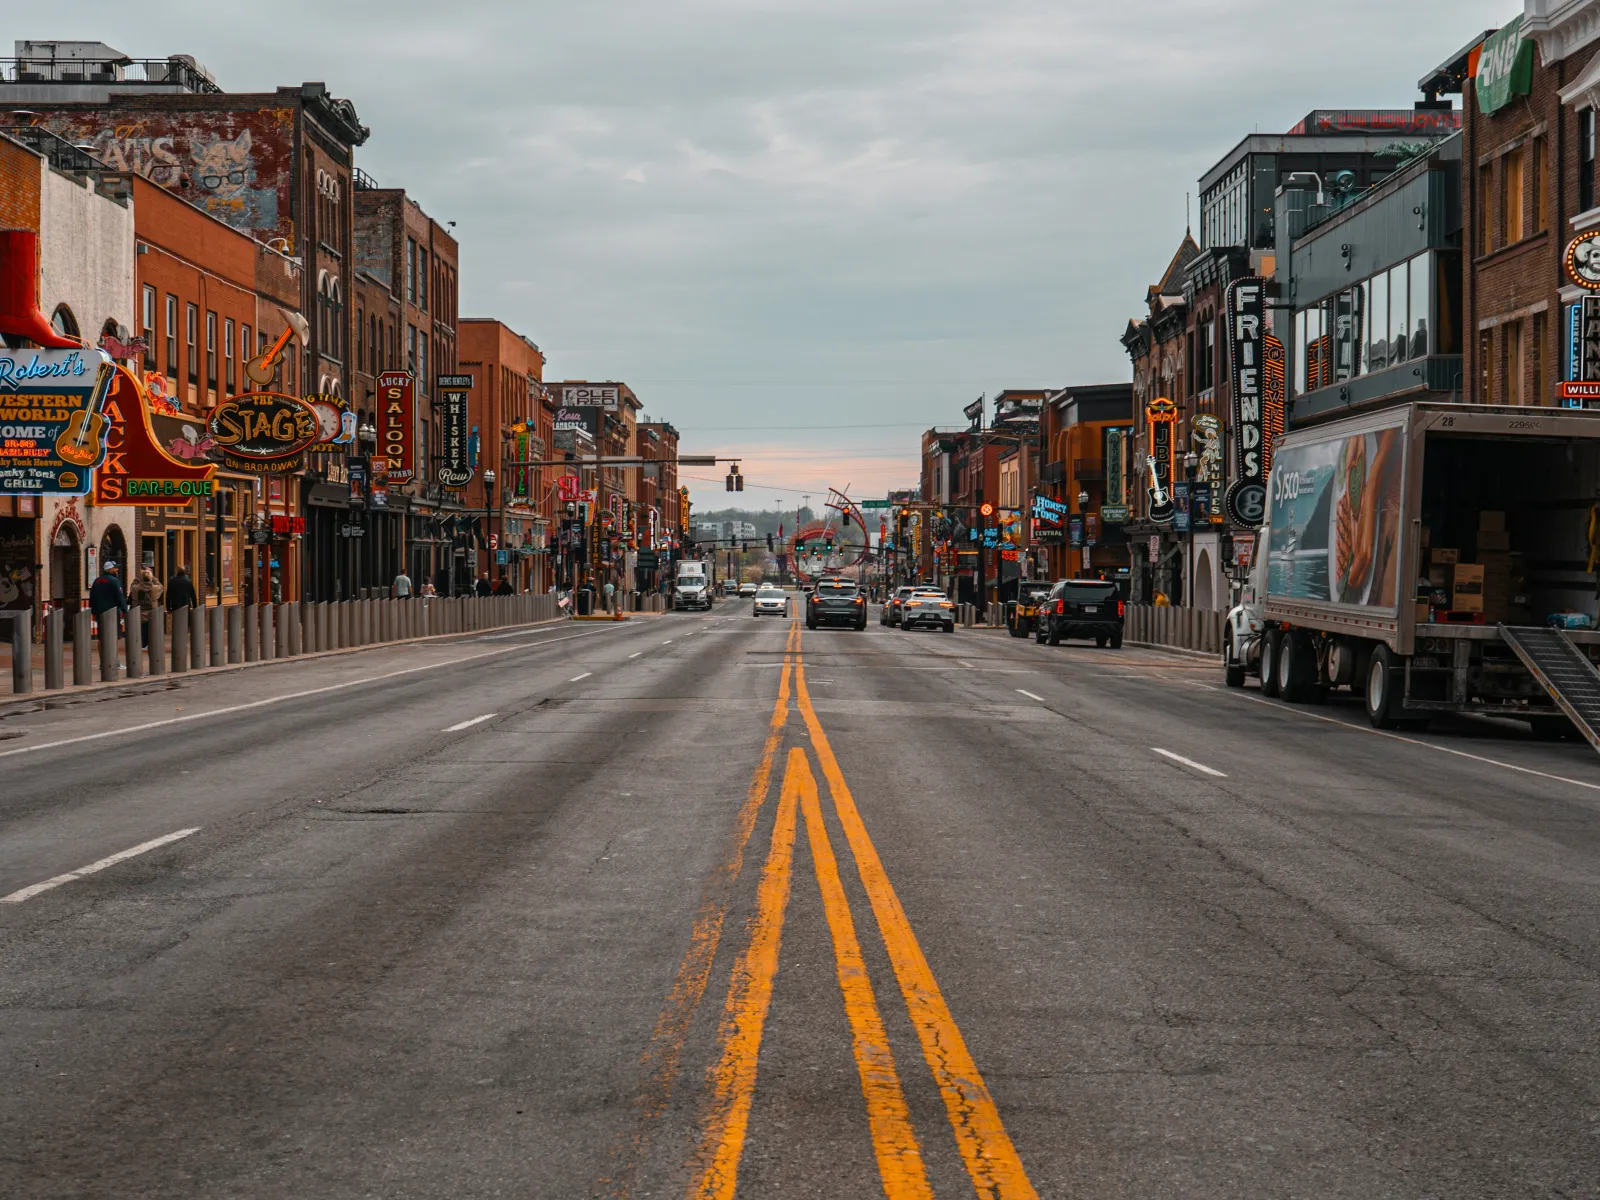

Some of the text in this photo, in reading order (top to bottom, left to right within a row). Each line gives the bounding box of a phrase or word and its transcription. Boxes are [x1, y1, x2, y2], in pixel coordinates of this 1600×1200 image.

[97, 130, 180, 187] ATS
[0, 352, 85, 389] Robert's
[380, 376, 410, 387] LUCKY
[1236, 286, 1259, 477] FRIENDS
[1568, 385, 1600, 394] WILLI
[252, 395, 274, 405] THE
[319, 393, 347, 409] TIME
[576, 389, 615, 398] OLE
[576, 397, 615, 406] RED
[557, 408, 581, 421] Rosa
[214, 402, 316, 446] STAGE
[386, 388, 404, 469] SALOON
[449, 393, 461, 468] WHISKEY
[0, 425, 60, 441] OME of
[101, 374, 129, 500] JACKS
[1156, 428, 1170, 479] JBJ
[13, 459, 32, 467] Tonk
[34, 459, 63, 467] Heaven
[226, 457, 300, 472] ON BROADWAY
[29, 469, 57, 480] Tonk
[388, 469, 412, 478] STARD
[441, 468, 468, 485] Row
[4, 480, 43, 489] GRILL
[127, 481, 212, 495] BAR-B-QUE
[1036, 495, 1067, 513] HONKY
[1032, 506, 1059, 523] TONK
